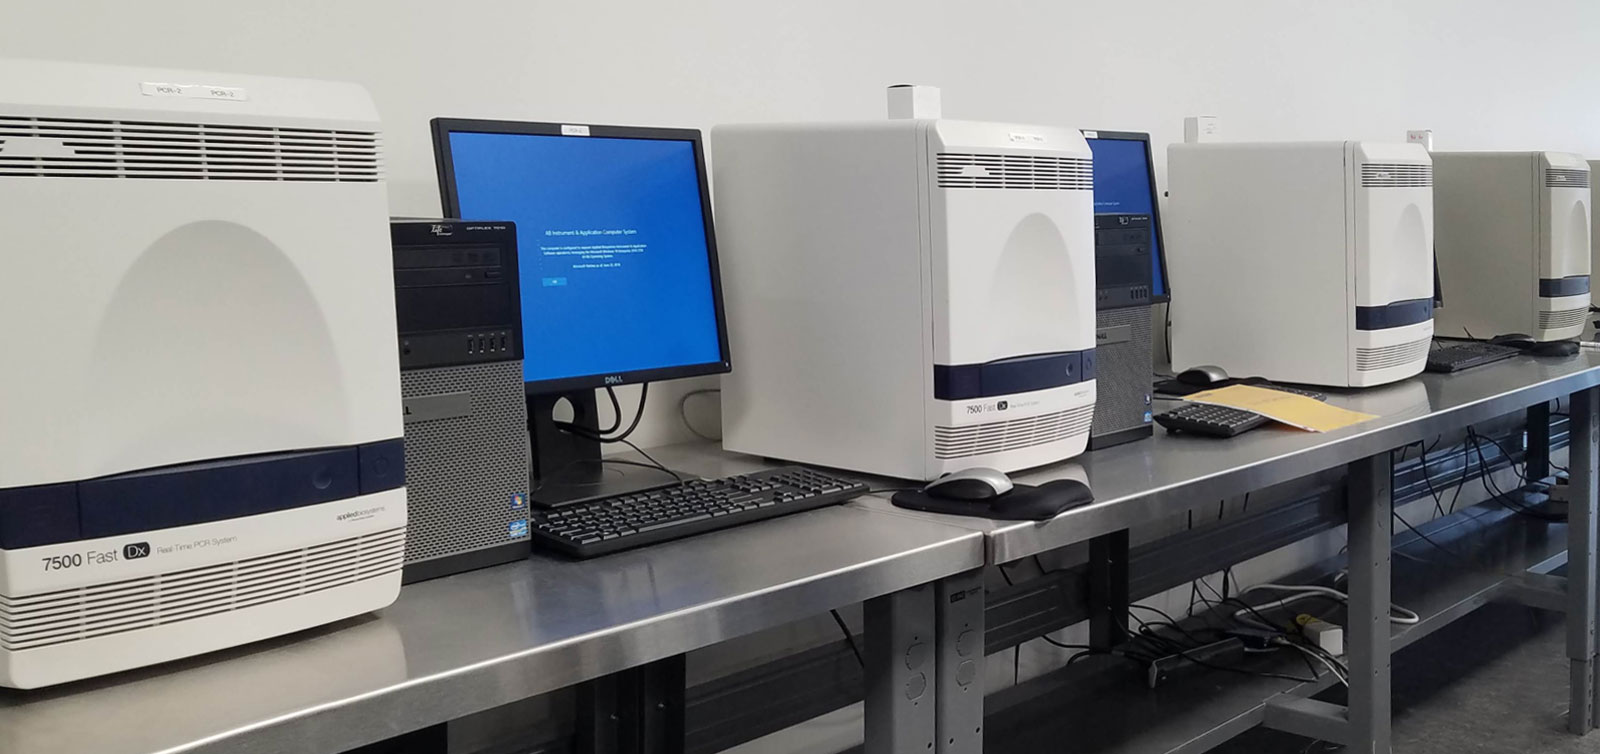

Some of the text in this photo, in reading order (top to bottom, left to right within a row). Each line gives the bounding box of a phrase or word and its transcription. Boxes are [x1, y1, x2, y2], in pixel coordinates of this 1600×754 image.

[604, 375, 623, 385] DELL
[966, 404, 982, 415] 7500
[983, 403, 996, 413] Fast
[42, 553, 82, 571] 7500
[86, 549, 119, 565] Fast
[127, 545, 145, 558] Dx
[193, 540, 211, 549] PCR
[211, 536, 238, 547] System
